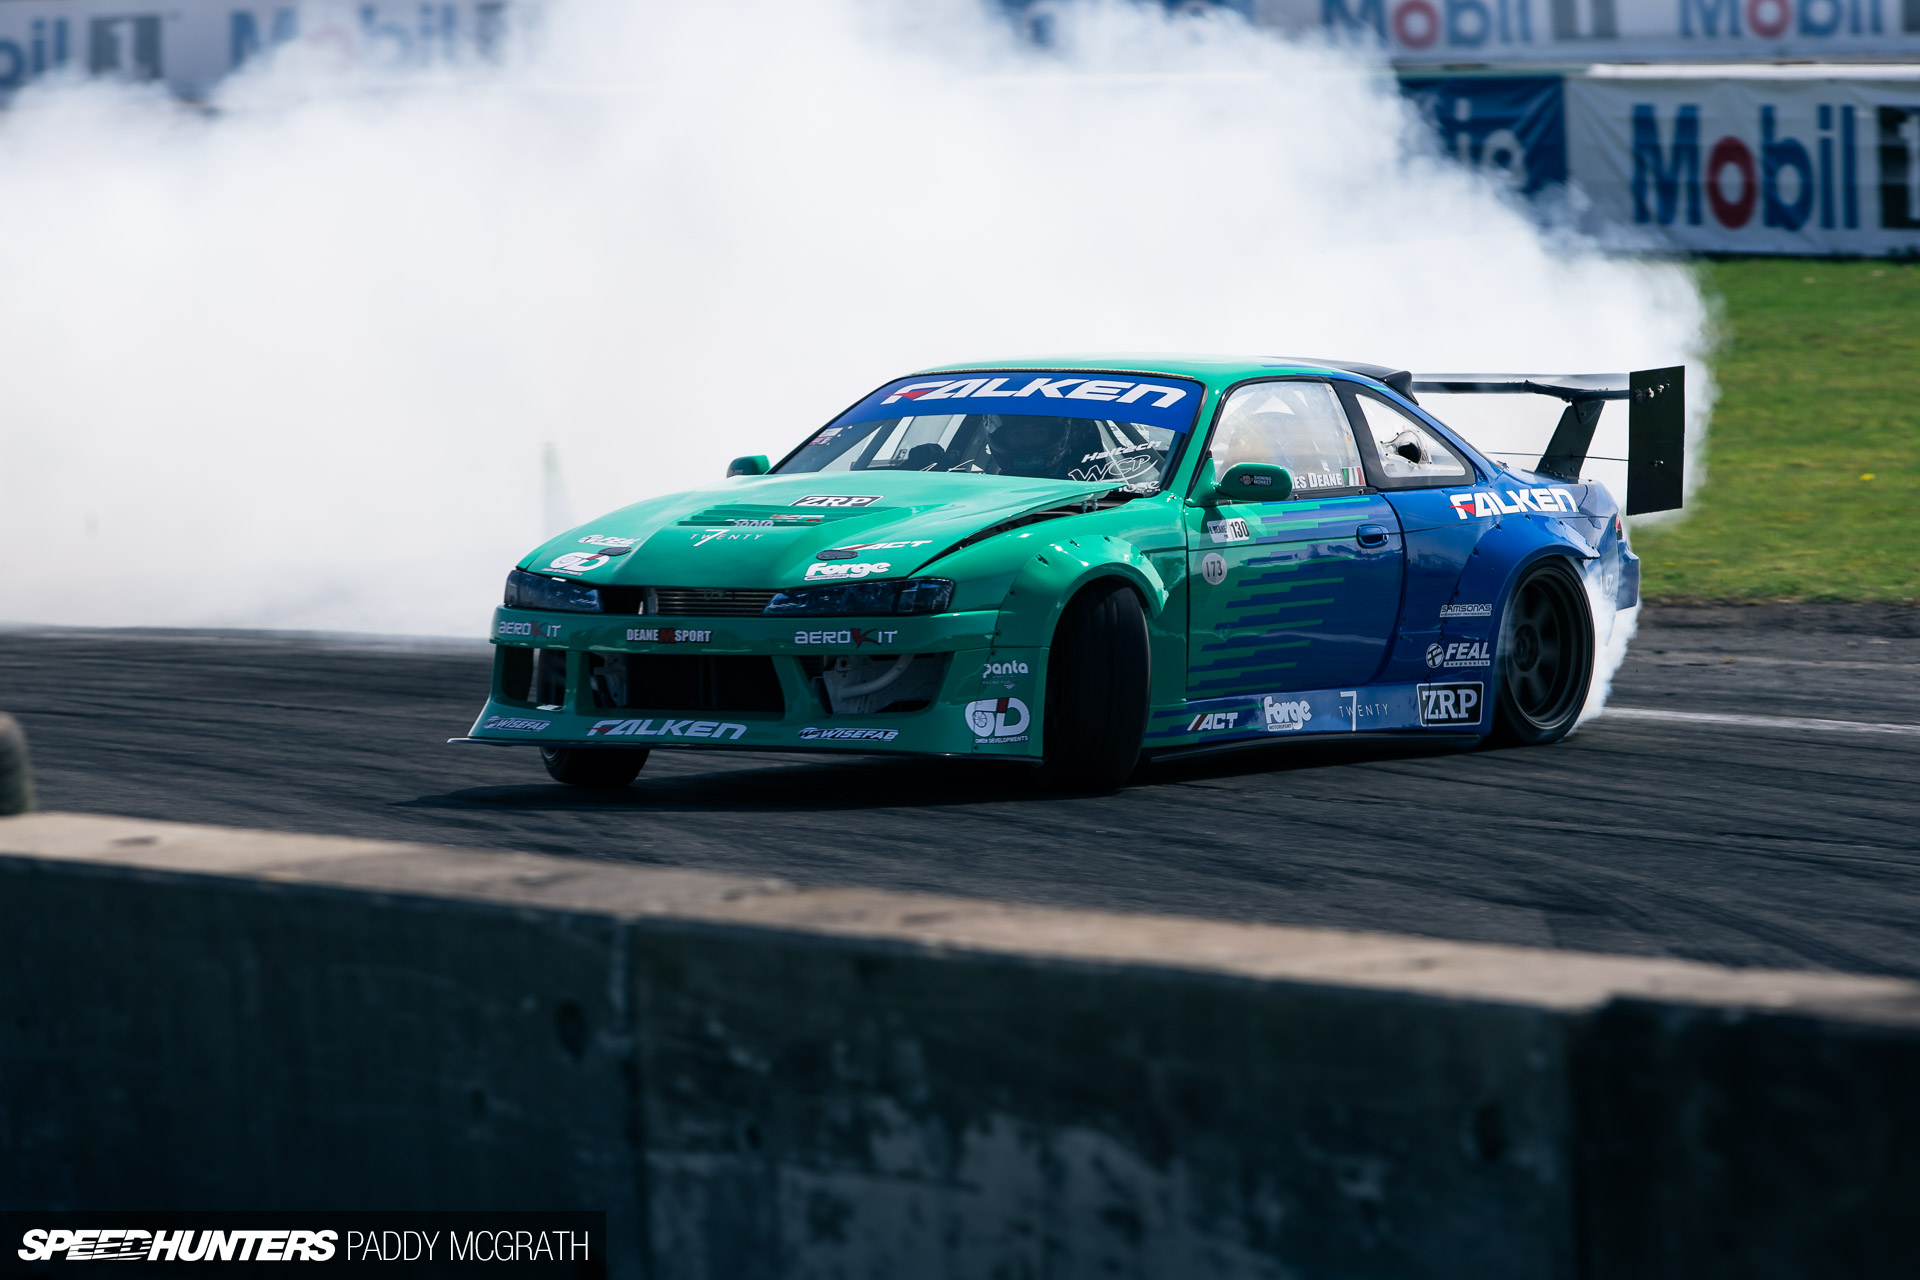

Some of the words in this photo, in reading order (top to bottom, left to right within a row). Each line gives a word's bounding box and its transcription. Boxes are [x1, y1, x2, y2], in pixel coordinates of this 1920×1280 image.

[1632, 103, 1859, 231] Mobil
[881, 377, 1188, 409] FALKEN
[1307, 472, 1343, 488] DEANE
[795, 496, 874, 507] ZRP
[1450, 487, 1580, 520] FALKEN
[1230, 520, 1250, 538] 130
[804, 561, 892, 579] Forge
[1205, 560, 1223, 578] 173
[1441, 603, 1493, 613] SAMSONAS
[1445, 642, 1491, 660] FEAL
[982, 660, 1029, 678] panta
[1263, 696, 1312, 730] Forge
[1422, 688, 1478, 721] ZRP
[586, 719, 748, 740] FALKEN
[820, 727, 899, 740] WISEFAB
